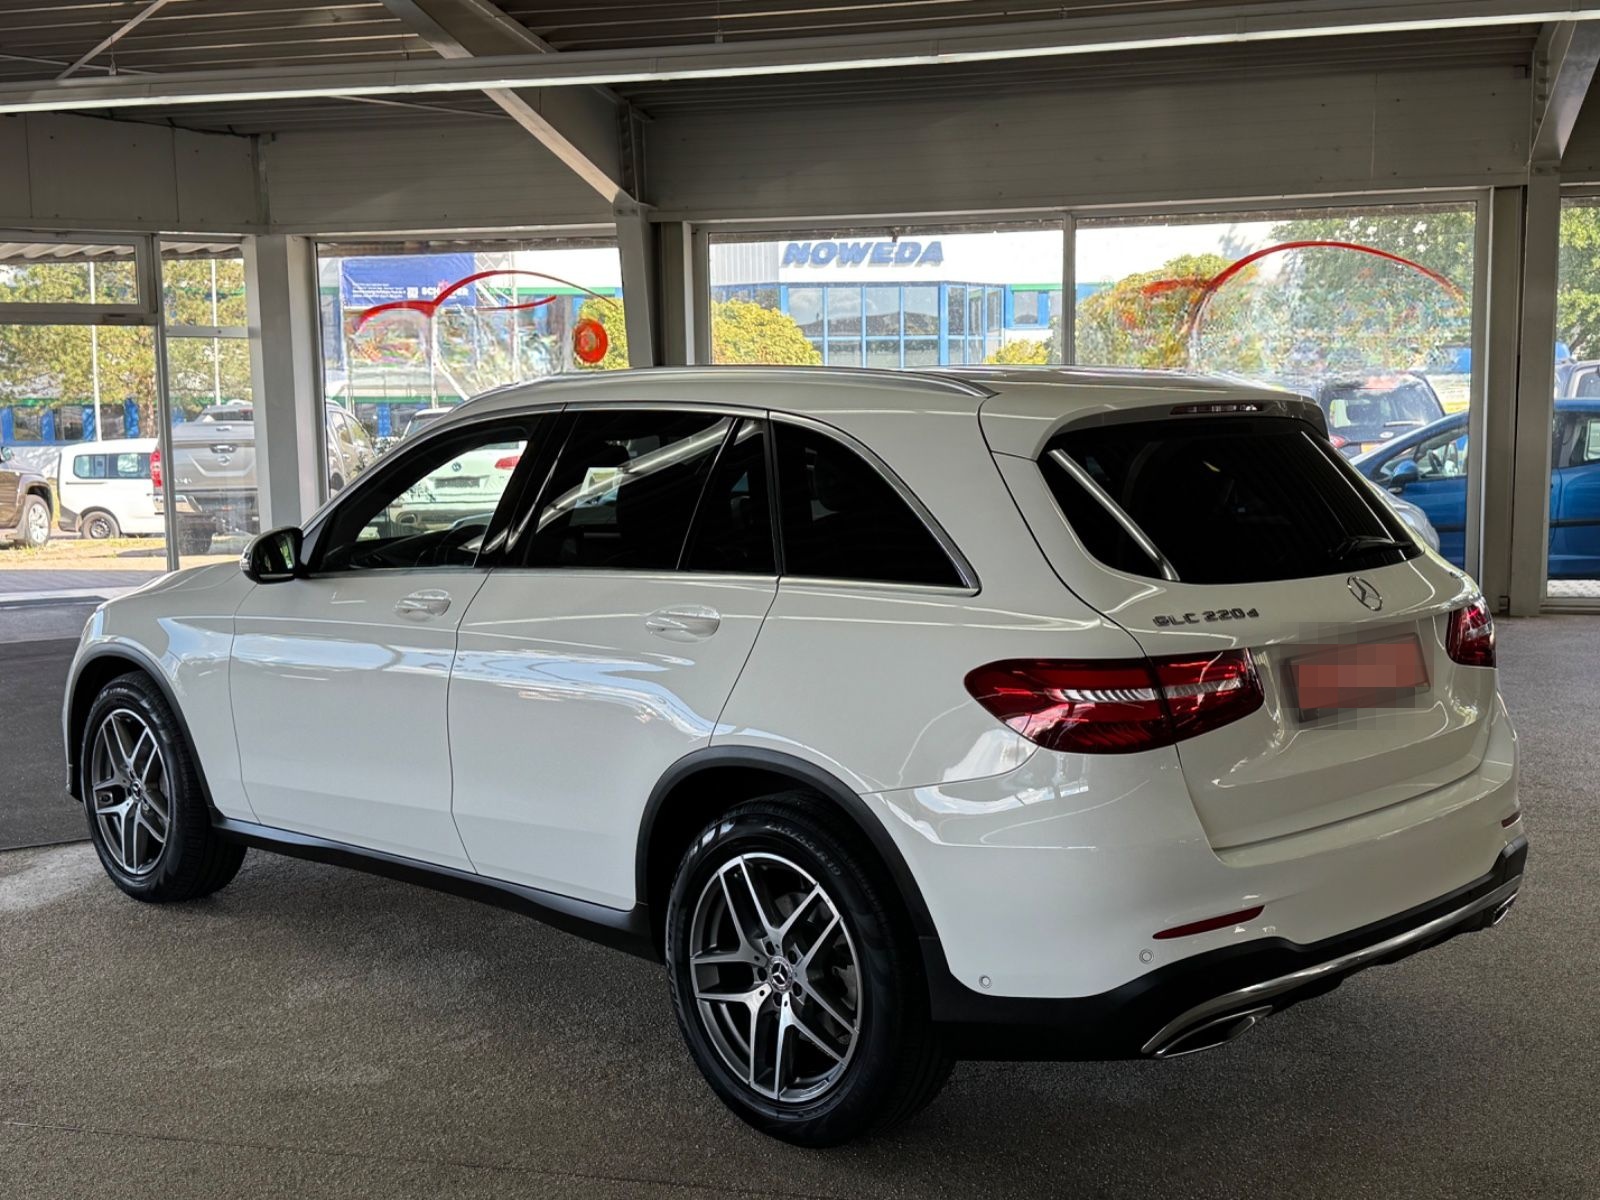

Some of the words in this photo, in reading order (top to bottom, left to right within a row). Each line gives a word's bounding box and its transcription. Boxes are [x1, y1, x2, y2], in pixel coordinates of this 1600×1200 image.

[782, 242, 944, 266] NOWEDA
[1152, 613, 1199, 626] GLC
[1202, 608, 1259, 622] 220d
